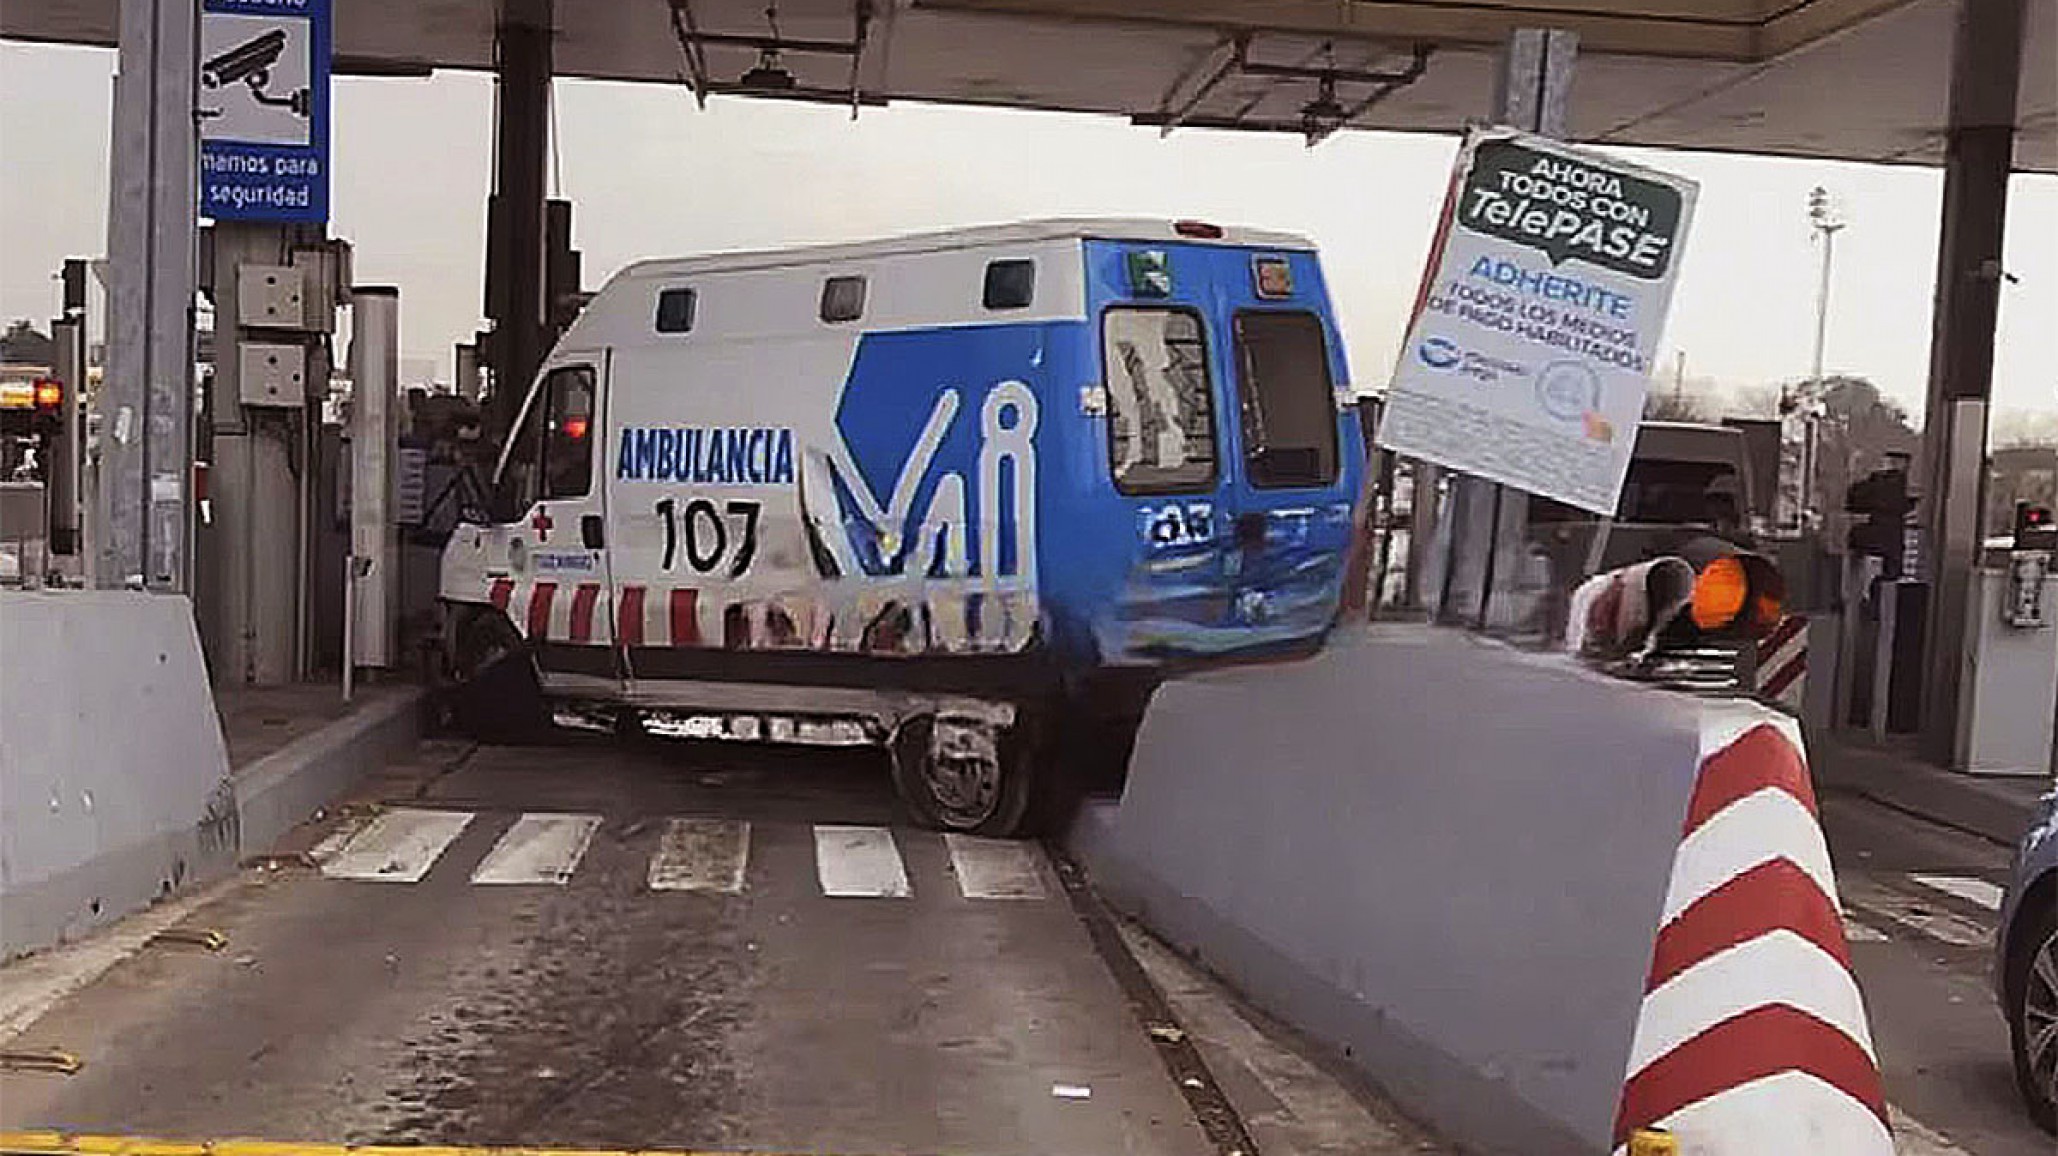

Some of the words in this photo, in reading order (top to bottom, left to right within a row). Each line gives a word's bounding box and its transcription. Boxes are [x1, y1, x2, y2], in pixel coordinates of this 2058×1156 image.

[275, 158, 318, 176] para
[1531, 158, 1623, 199] AHORA
[209, 184, 309, 209] seguridad
[1498, 170, 1588, 210] TODOS
[1590, 197, 1649, 228] CON
[1469, 187, 1669, 267] TelePASE
[1470, 255, 1633, 320] ADHERITE
[617, 428, 794, 483] AMBULANCIA
[656, 499, 761, 579] 107
